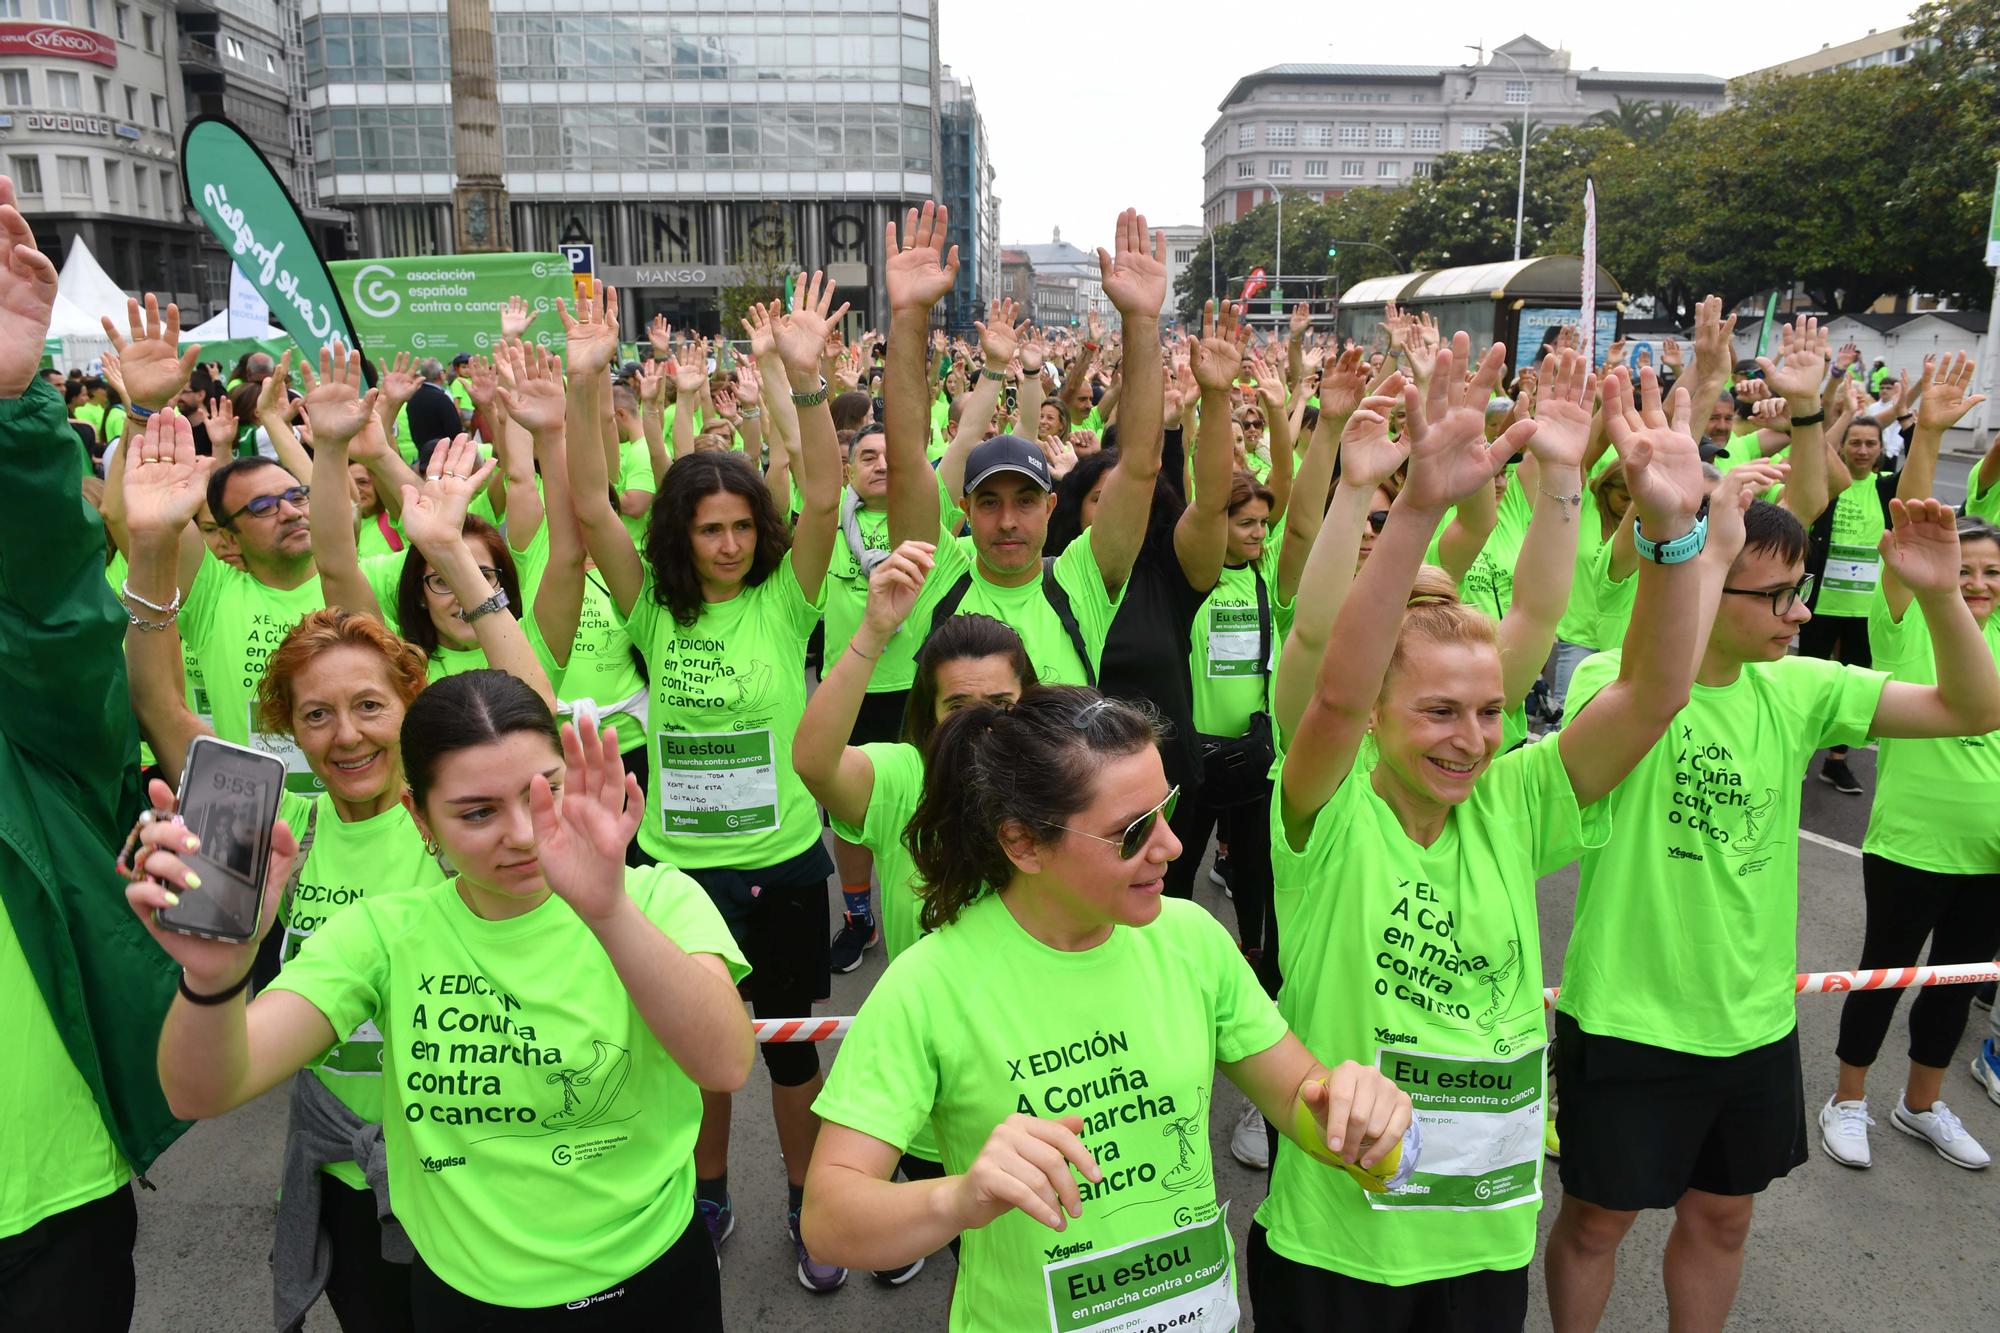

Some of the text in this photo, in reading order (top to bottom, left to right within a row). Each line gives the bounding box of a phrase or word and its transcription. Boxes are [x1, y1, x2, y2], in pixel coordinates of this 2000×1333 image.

[35, 32, 93, 51] SVENSON
[29, 116, 109, 132] avante
[561, 215, 865, 249] ANGO
[568, 249, 584, 270] P
[407, 269, 476, 281] asociación
[636, 269, 706, 283] MANGO
[409, 285, 468, 299] española
[410, 301, 450, 312] contra
[455, 303, 463, 312] o
[253, 614, 262, 625] X
[1216, 612, 1259, 622] Eu estou
[248, 630, 260, 642] A
[246, 647, 267, 658] en
[667, 639, 676, 654] A
[664, 659, 678, 672] en
[243, 677, 253, 688] o
[661, 676, 705, 695] contra
[660, 693, 725, 709] o cancro
[1682, 725, 1693, 741] X
[667, 741, 736, 755] Eu estou
[704, 758, 729, 766] contra
[737, 755, 762, 765] cancro
[212, 772, 257, 798] 9:53
[1668, 810, 1682, 824] o
[1390, 897, 1409, 922] A
[1383, 926, 1415, 951] en
[1376, 951, 1453, 996] contra
[418, 973, 435, 994] X
[1375, 978, 1388, 996] o
[413, 1004, 428, 1030] A
[1374, 1027, 1418, 1045] Vegalsa
[411, 1040, 563, 1066] en marcha
[1006, 1031, 1129, 1082] X EDICIÓN
[406, 1070, 501, 1096] contra
[1395, 1060, 1513, 1090] Eu estou
[1016, 1066, 1149, 1118] A Coruña
[1410, 1086, 1535, 1106] marcha contra o cancro
[405, 1102, 537, 1126] o cancro
[420, 1156, 467, 1171] Vegalsa
[1077, 1162, 1156, 1203] ancro
[1044, 1240, 1093, 1259] Vegalsa
[1067, 1273, 1106, 1301] Eu
[1113, 1246, 1191, 1287] estou
[590, 1287, 625, 1304] Kalenji
[1071, 1308, 1090, 1320] en
[1092, 1291, 1140, 1315] marcha
[1142, 1277, 1183, 1297] contra
[1184, 1273, 1193, 1283] o
